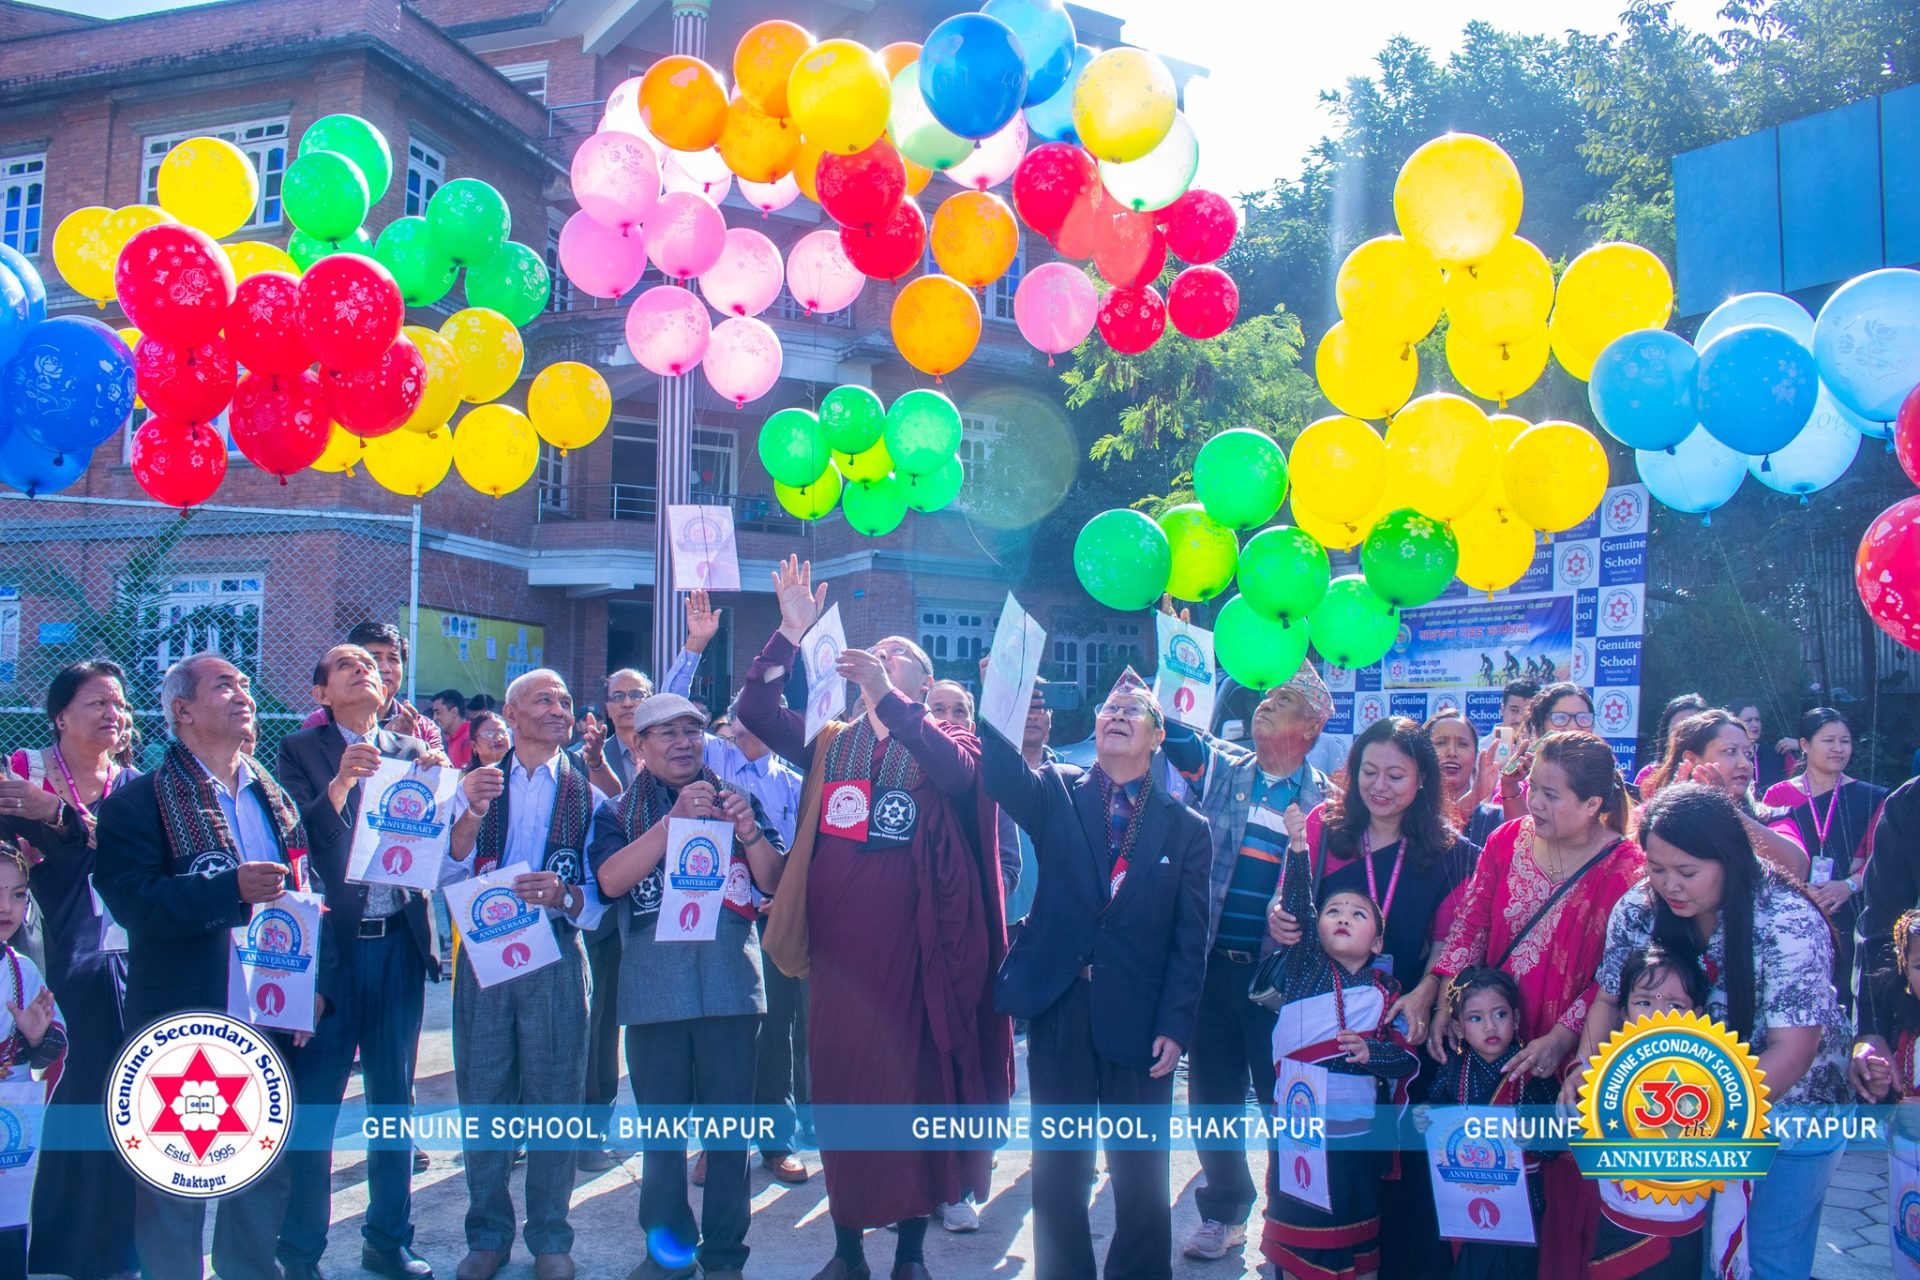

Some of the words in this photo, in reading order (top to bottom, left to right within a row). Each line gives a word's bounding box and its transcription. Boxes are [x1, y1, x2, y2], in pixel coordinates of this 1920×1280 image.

[1602, 538, 1647, 552] Genuine
[1604, 554, 1642, 568] School
[1597, 639, 1642, 651] Genuine
[1600, 654, 1637, 667] School
[1391, 695, 1426, 705] Genuine
[1469, 709, 1502, 720] School
[1612, 742, 1636, 754] uine
[394, 797, 421, 816] 30
[375, 818, 434, 834] ANNIVERSARY
[690, 855, 709, 870] 30
[677, 879, 717, 887] ANNIVERSARY
[486, 903, 512, 921] 30
[479, 915, 533, 939] ANNIVERSARY
[262, 927, 287, 947] 30
[245, 952, 301, 968] ANNIVERSARY
[1461, 1144, 1490, 1163] 30
[1448, 1170, 1510, 1181] ANNIVERSARY
